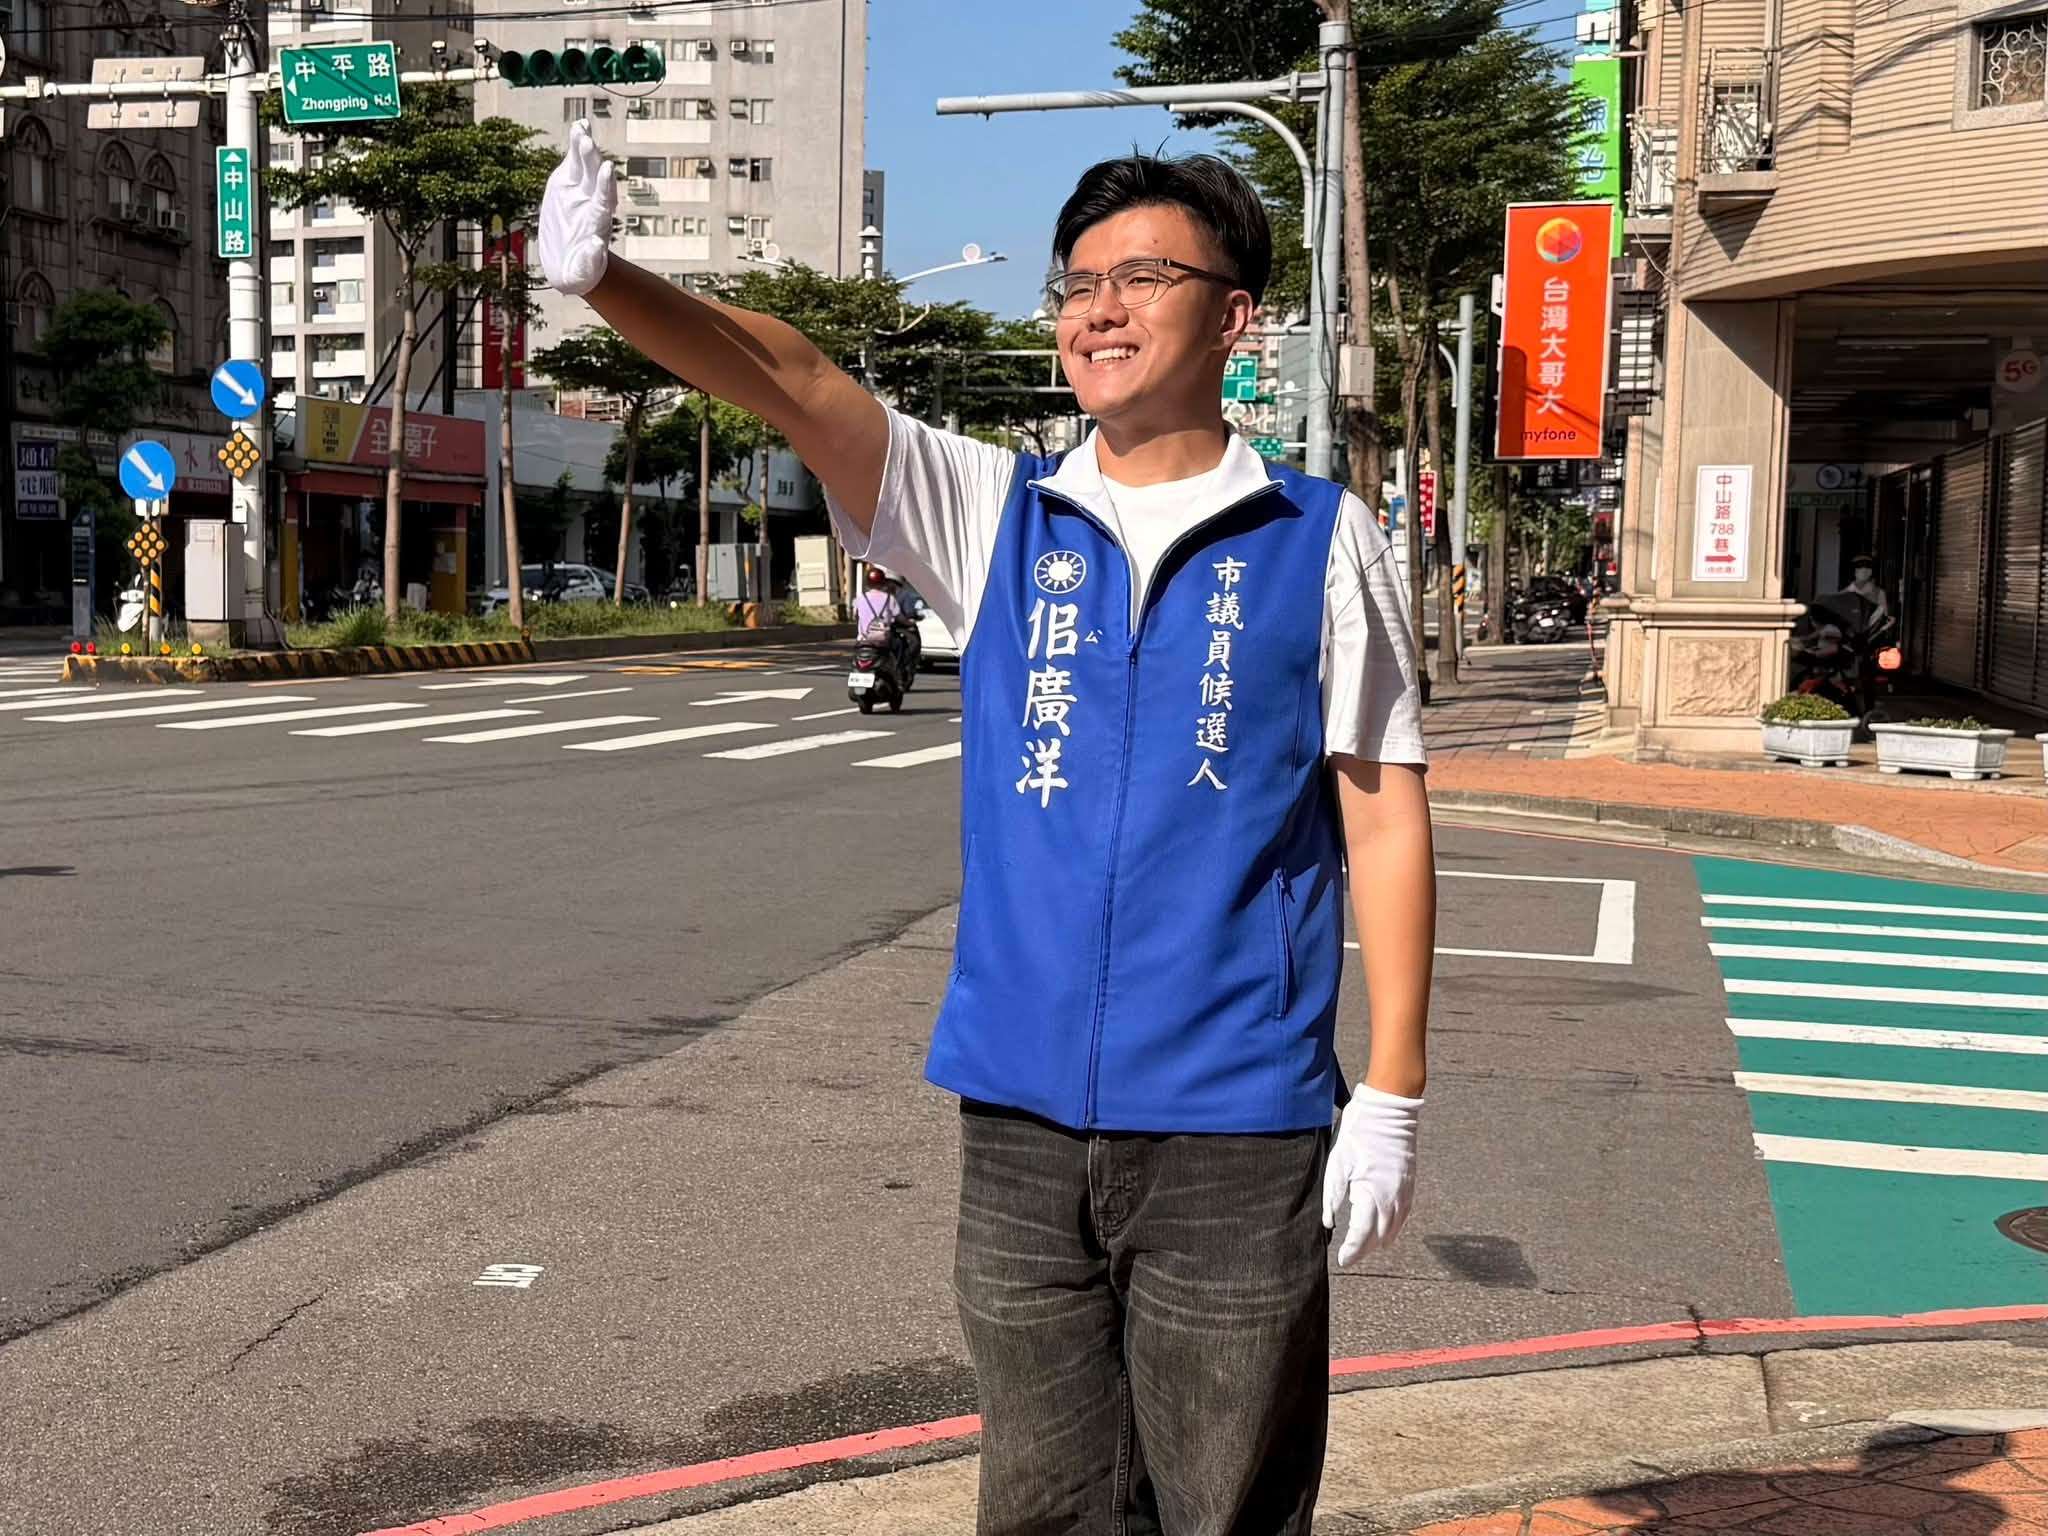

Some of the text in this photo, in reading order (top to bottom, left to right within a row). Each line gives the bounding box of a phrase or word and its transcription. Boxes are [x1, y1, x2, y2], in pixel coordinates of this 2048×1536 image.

[295, 53, 391, 82] 中平路
[301, 93, 396, 112] Zhongping Rd.
[223, 165, 245, 252] 中山路
[1535, 276, 1571, 415] 台灣大哥大
[2005, 360, 2038, 383] 5G
[1520, 427, 1577, 441] myfone
[1187, 556, 1247, 791] 市議員候選人
